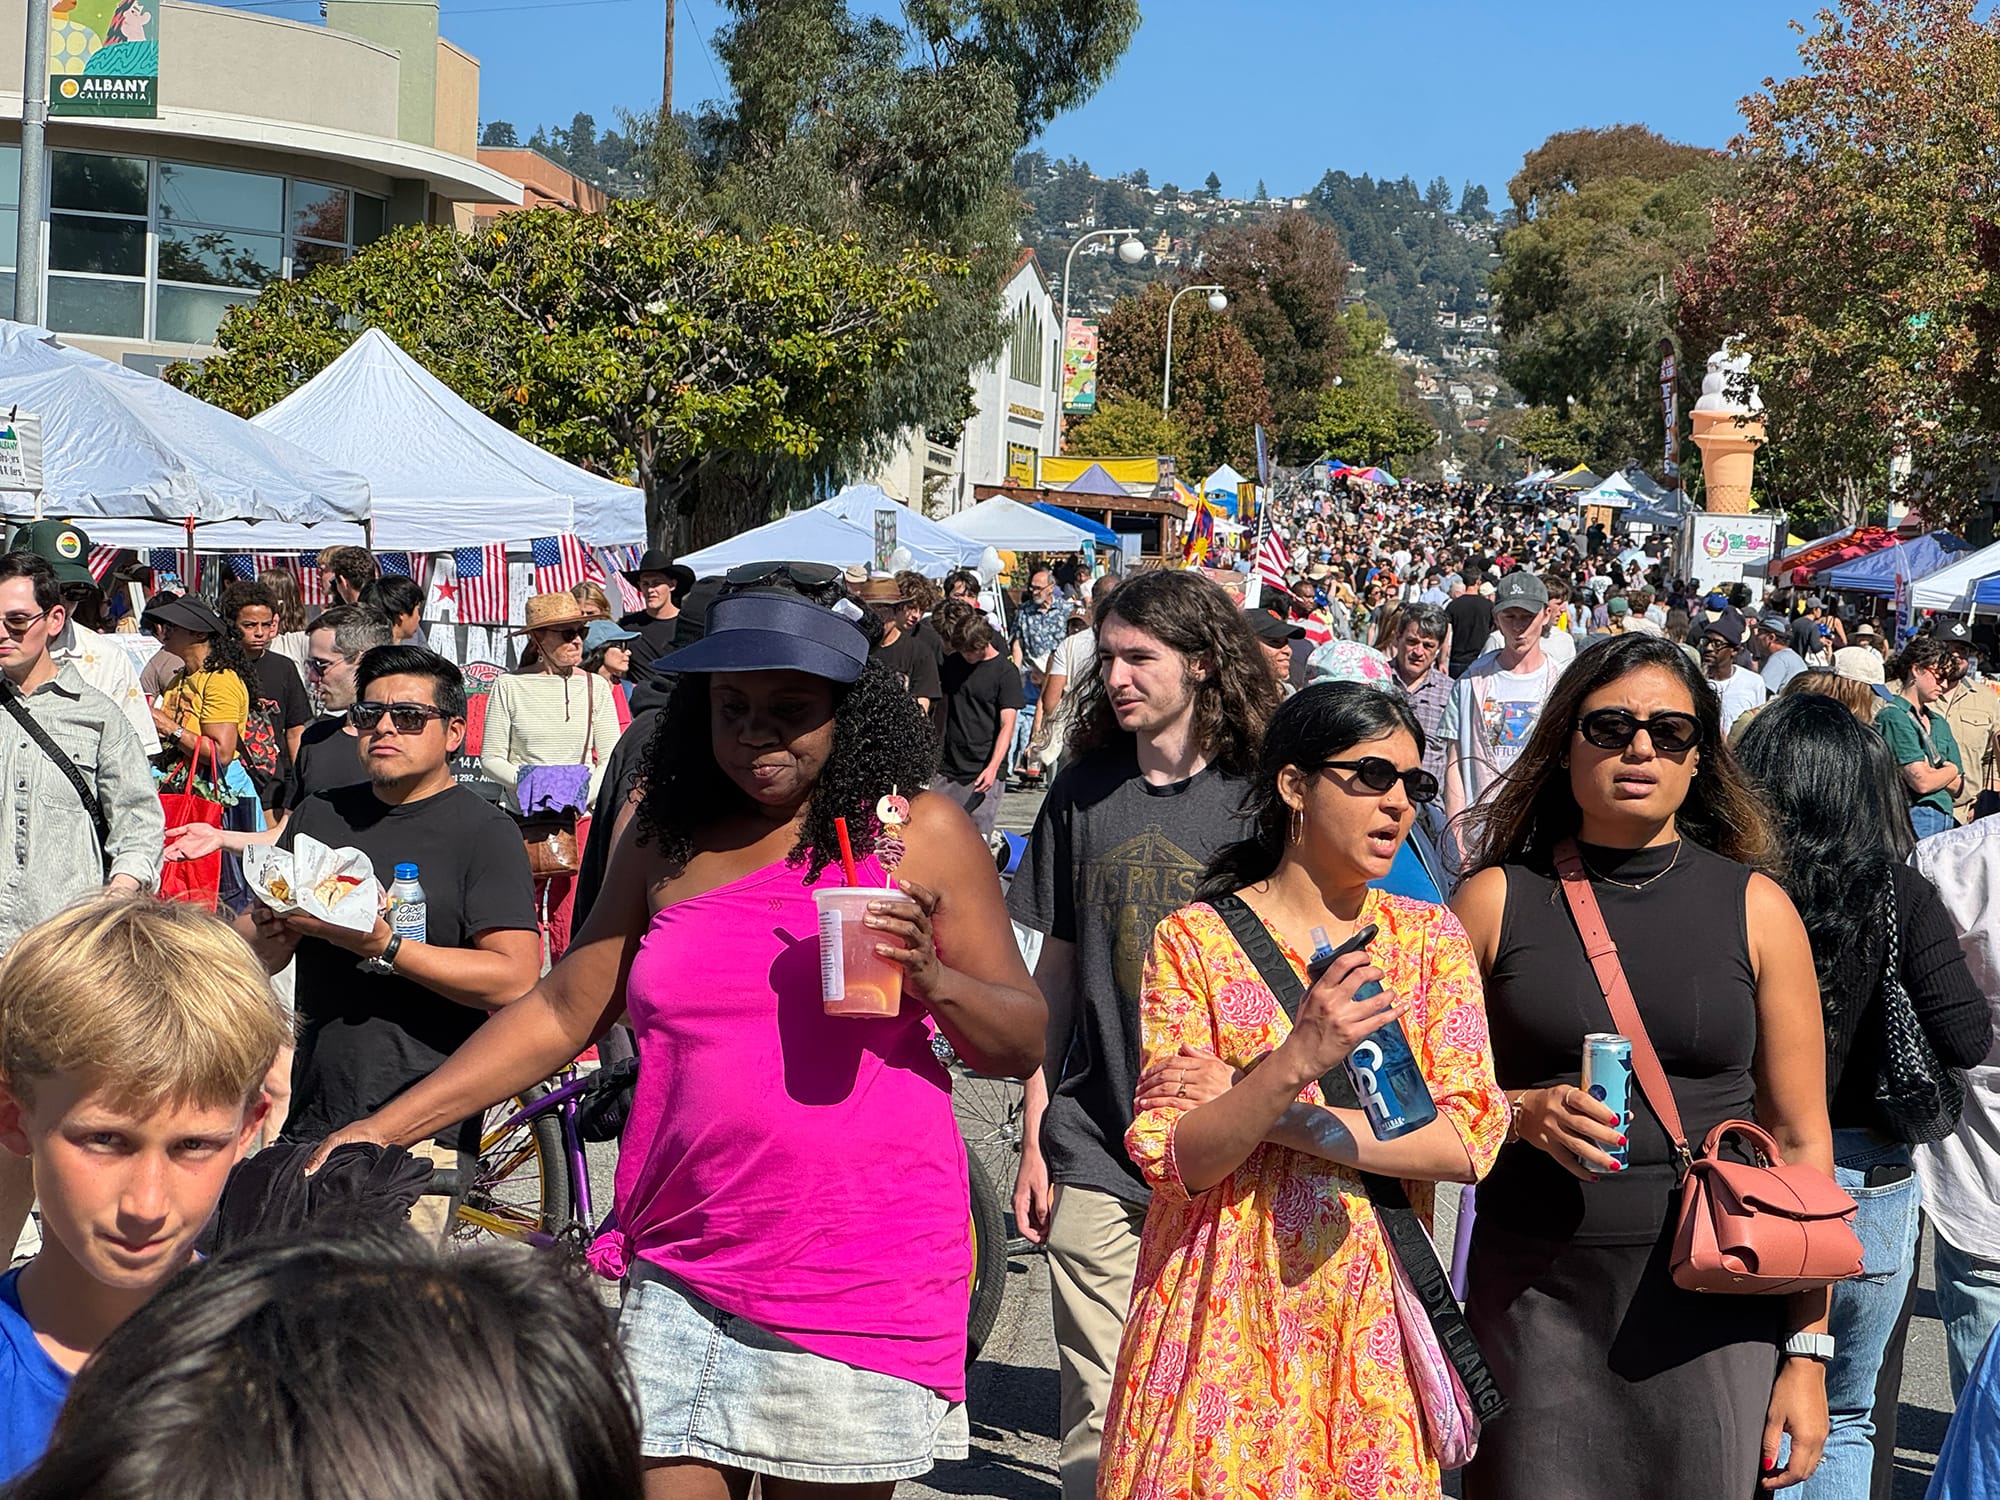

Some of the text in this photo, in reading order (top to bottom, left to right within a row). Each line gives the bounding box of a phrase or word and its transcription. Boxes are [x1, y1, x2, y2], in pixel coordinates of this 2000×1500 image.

[79, 91, 146, 100] CALIFORNIA
[82, 79, 149, 92] ALBANY
[459, 756, 471, 769] 14
[61, 760, 88, 793] BAGGU
[459, 773, 474, 783] 292
[1125, 866, 1197, 905] PRES
[1215, 897, 1283, 974] SANDY
[1393, 1217, 1500, 1413] SANDY LIANG
